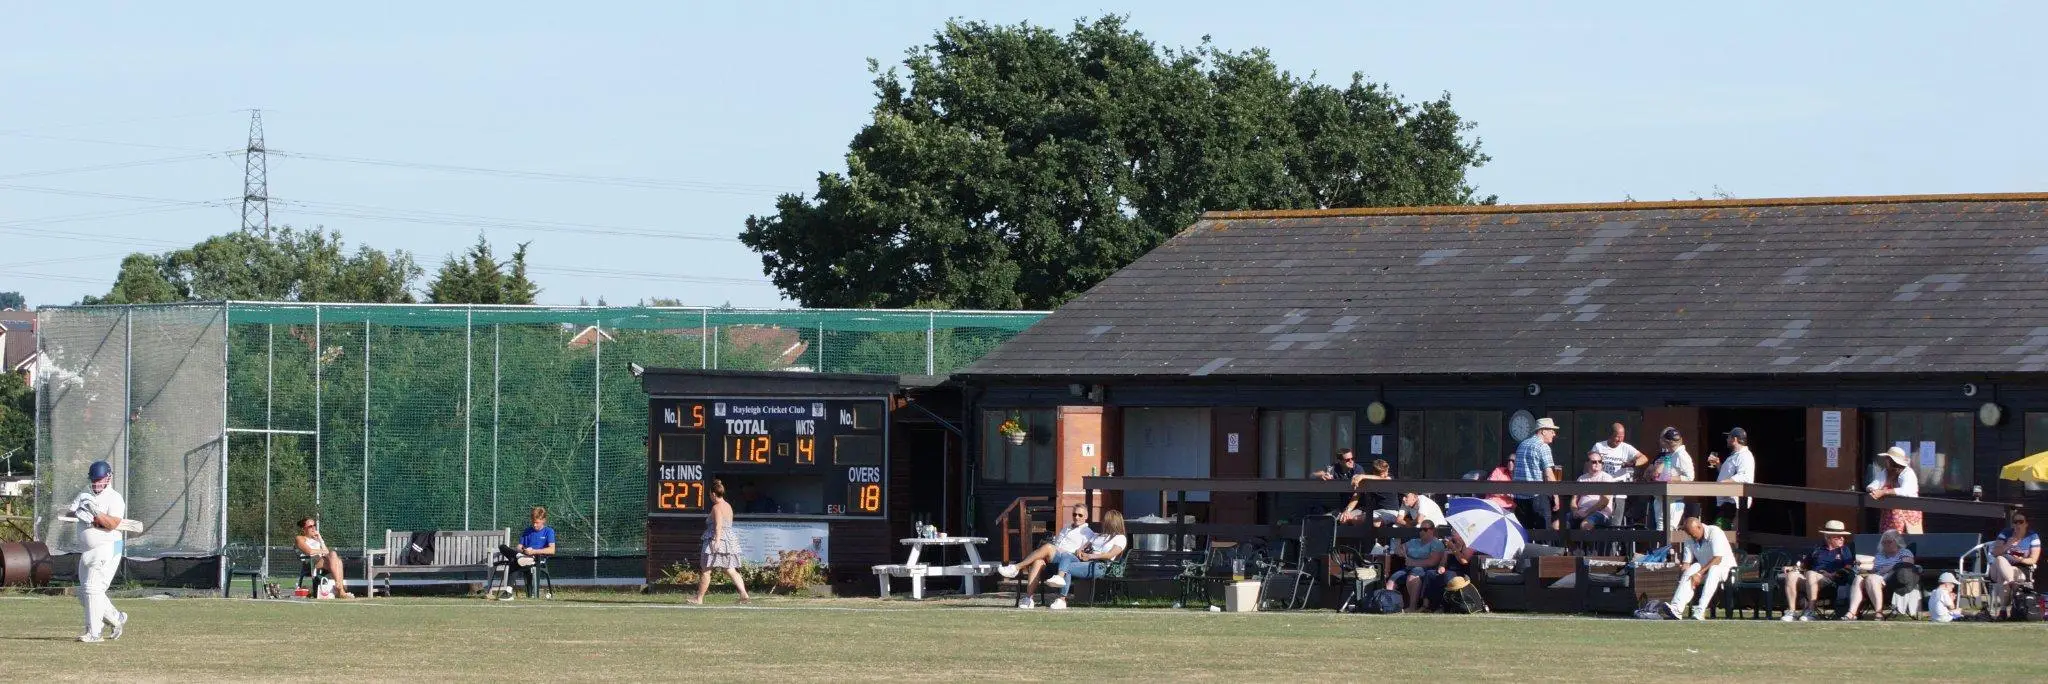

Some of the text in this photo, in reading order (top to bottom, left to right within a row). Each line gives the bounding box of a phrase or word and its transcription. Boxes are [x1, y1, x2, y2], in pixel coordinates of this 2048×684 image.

[665, 408, 677, 424] No.
[692, 405, 704, 428] 5
[733, 405, 805, 415] Rayleigh Cricket Club
[840, 409, 853, 425] No.
[726, 420, 768, 435] TOTAL
[796, 420, 815, 435] WKTS
[735, 437, 769, 463] 112
[799, 438, 813, 462] 4
[660, 464, 702, 480] 1st INNS
[849, 467, 880, 482] OVERS
[660, 483, 703, 508] 227
[860, 485, 880, 512] 18
